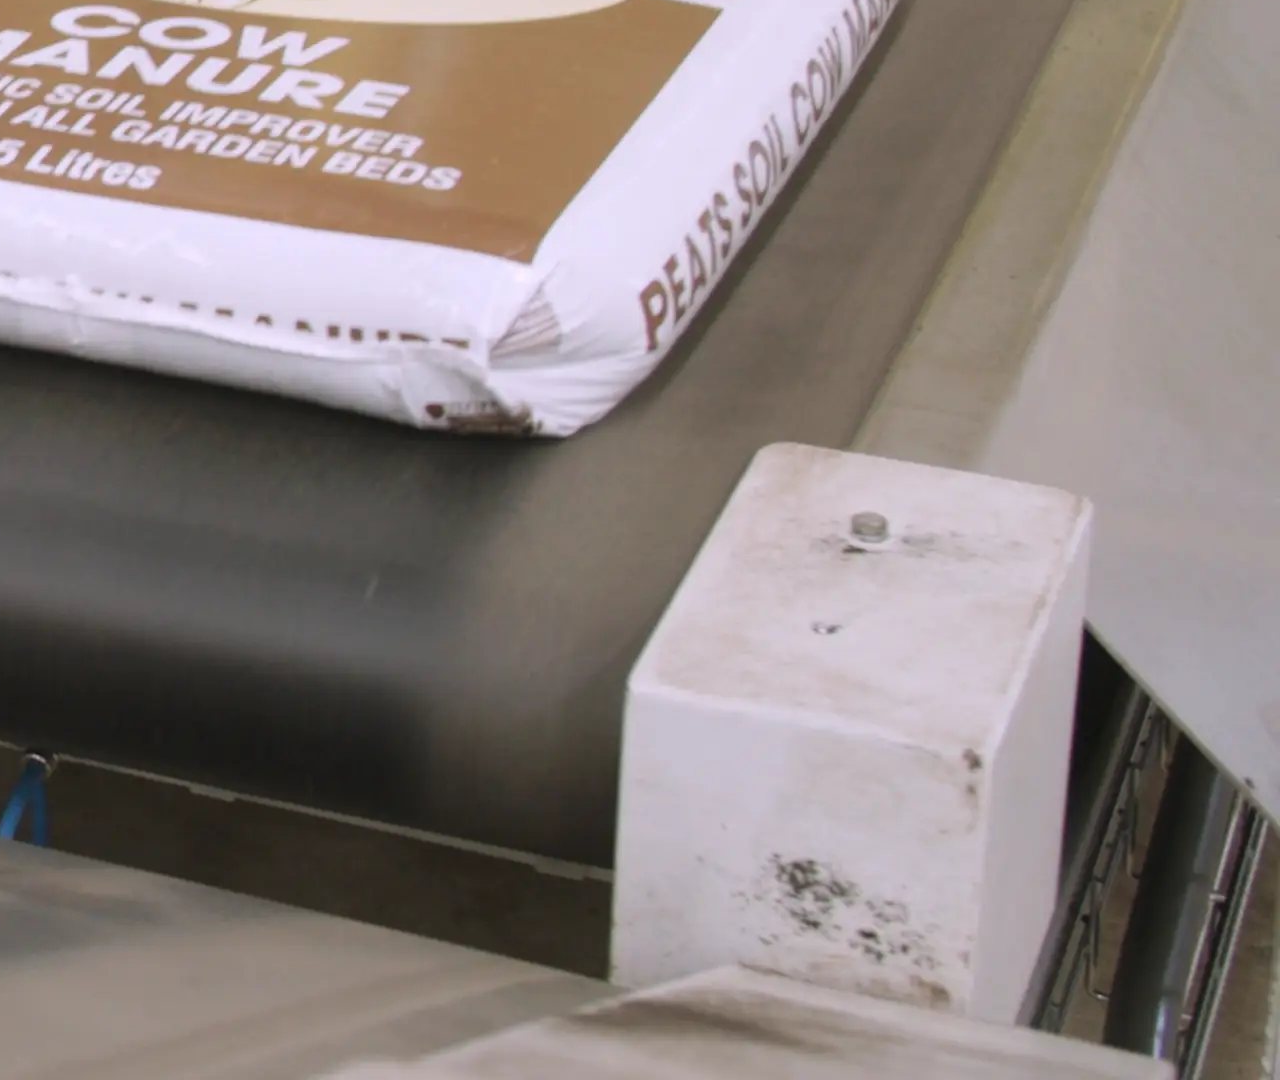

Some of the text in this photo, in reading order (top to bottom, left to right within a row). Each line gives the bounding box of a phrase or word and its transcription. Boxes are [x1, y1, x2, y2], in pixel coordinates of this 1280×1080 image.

[50, 4, 351, 67] COW
[10, 105, 97, 137] ALL
[110, 119, 319, 169] GARDEN
[321, 151, 463, 191] BEDS
[44, 83, 146, 118] SOIL
[159, 100, 424, 158] IMPROVER
[24, 144, 162, 190] Litres
[639, 191, 734, 353] PEATS
[732, 112, 790, 231] SOIL
[791, 26, 842, 146] COW
